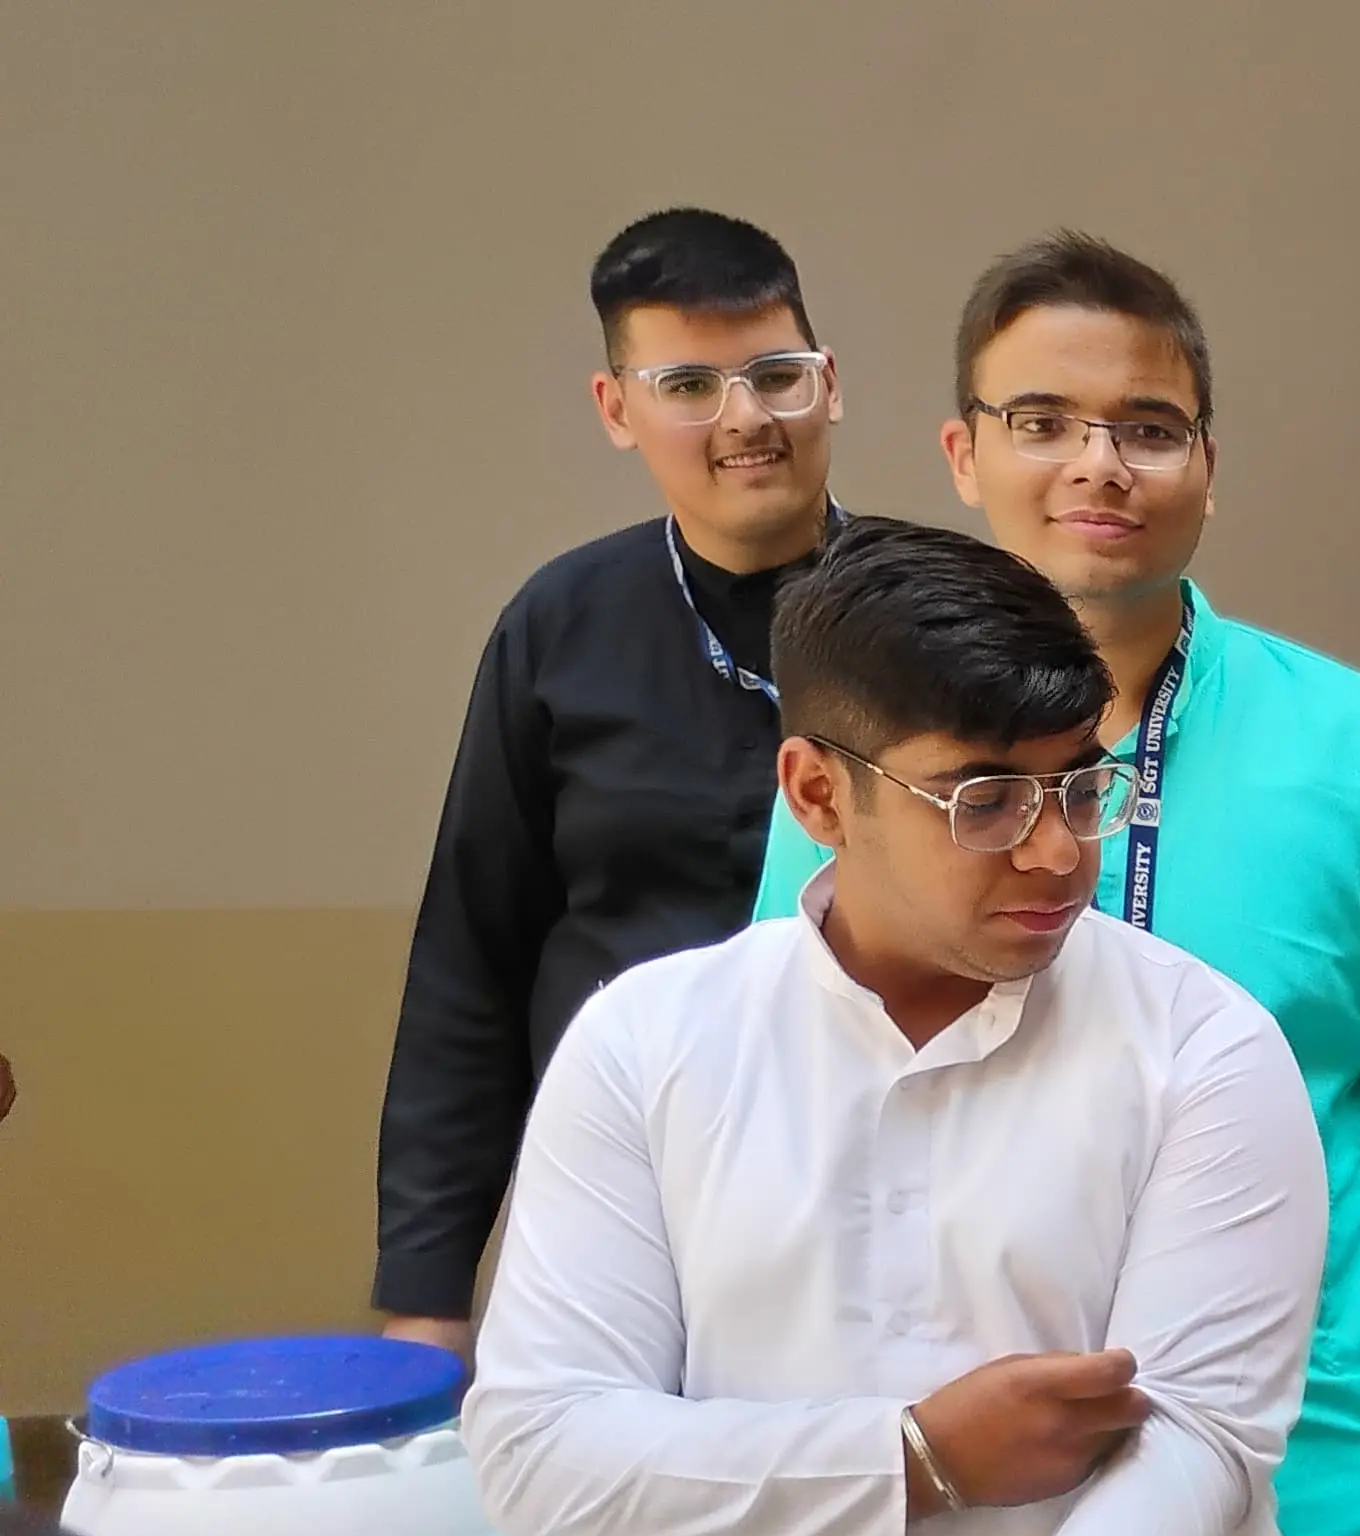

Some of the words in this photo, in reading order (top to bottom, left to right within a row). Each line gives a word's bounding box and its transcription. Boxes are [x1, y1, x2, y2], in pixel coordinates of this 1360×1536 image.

[1145, 665, 1180, 752] UNIVERSITY
[1142, 756, 1159, 794] SGT
[1132, 841, 1151, 928] IVERSITY
